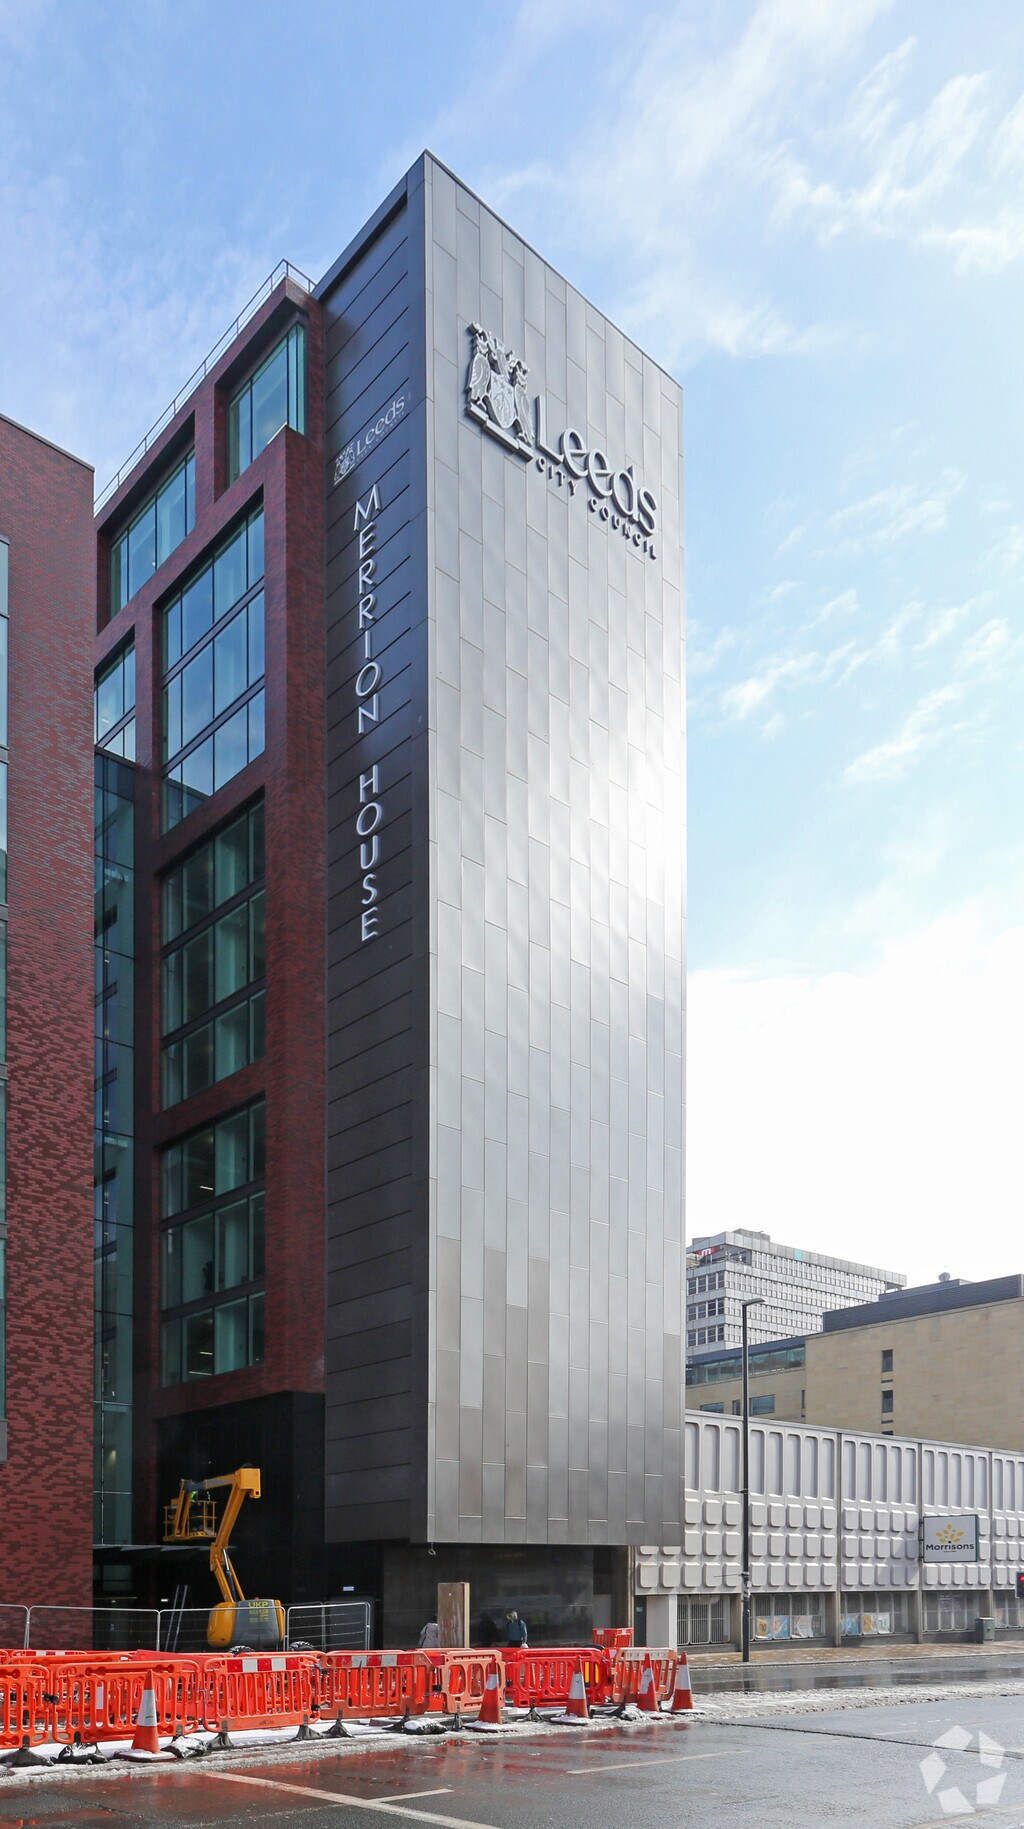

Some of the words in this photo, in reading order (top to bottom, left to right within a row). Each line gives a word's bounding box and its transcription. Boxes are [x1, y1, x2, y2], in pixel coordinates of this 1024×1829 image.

[356, 395, 405, 457] Leeds
[536, 394, 657, 538] Leeds
[536, 456, 577, 496] CITY
[588, 497, 657, 560] COUNCIL
[353, 483, 382, 736] MERRION
[355, 763, 383, 943] HOUSE
[925, 1541, 975, 1551] Morrisons
